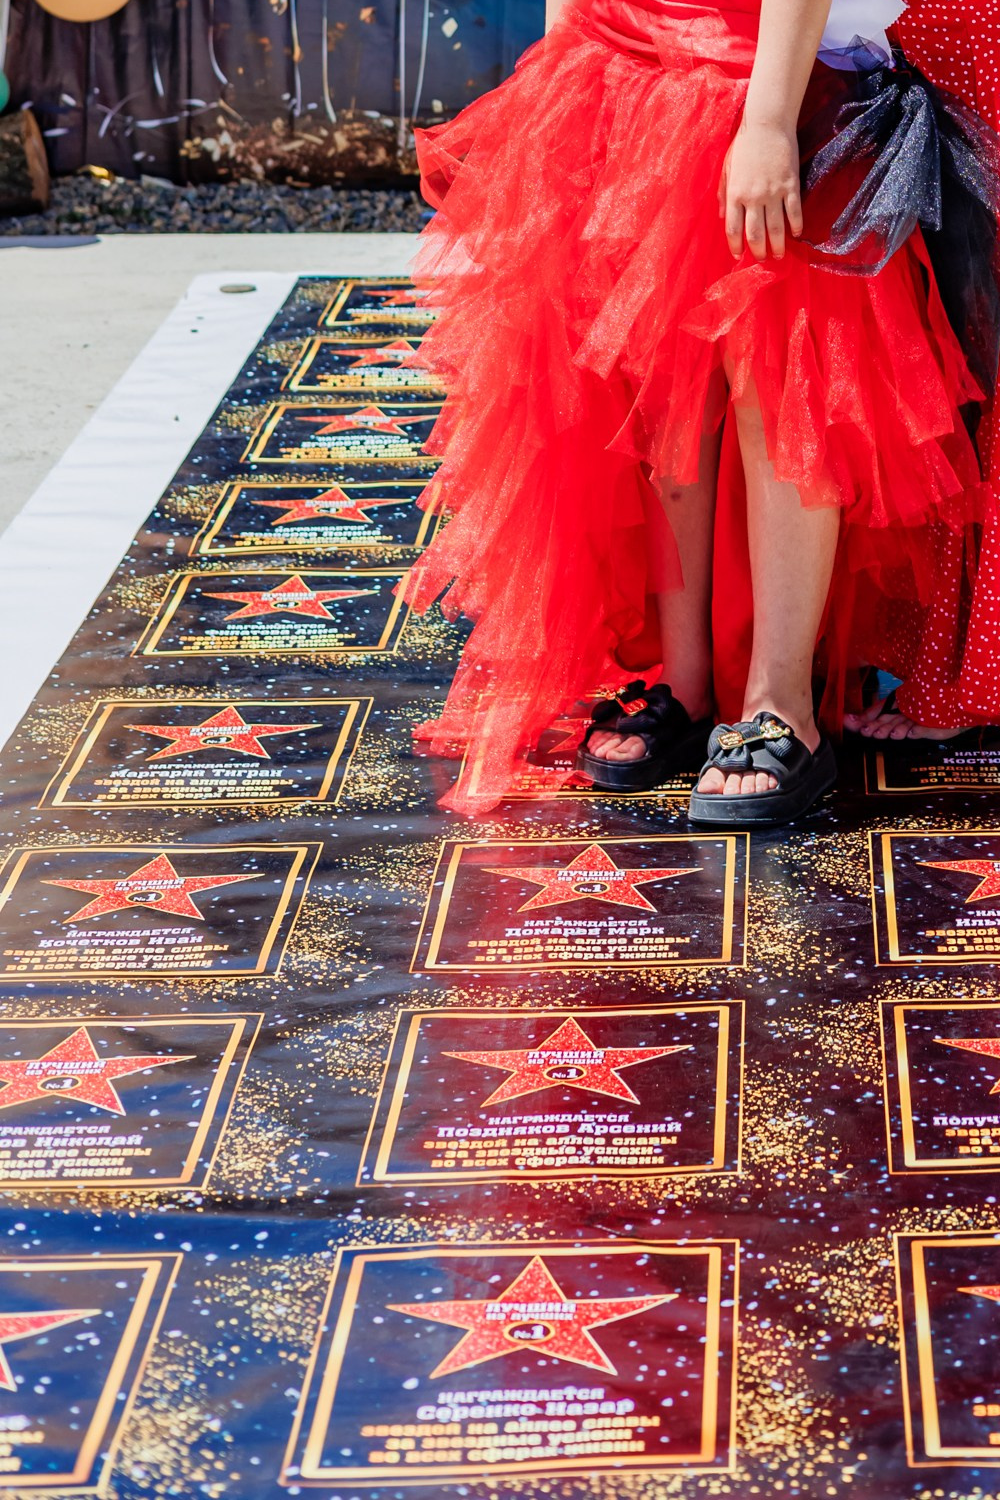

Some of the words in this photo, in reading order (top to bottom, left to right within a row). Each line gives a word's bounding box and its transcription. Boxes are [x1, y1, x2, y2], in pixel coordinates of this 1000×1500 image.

[212, 769, 282, 778] Тигран
[608, 927, 665, 936] Марк
[148, 936, 203, 945] Иван
[438, 1124, 569, 1137] Поздняков
[578, 1122, 681, 1135] Арсений
[34, 1135, 143, 1147] Николай
[546, 1400, 635, 1416] Назар
